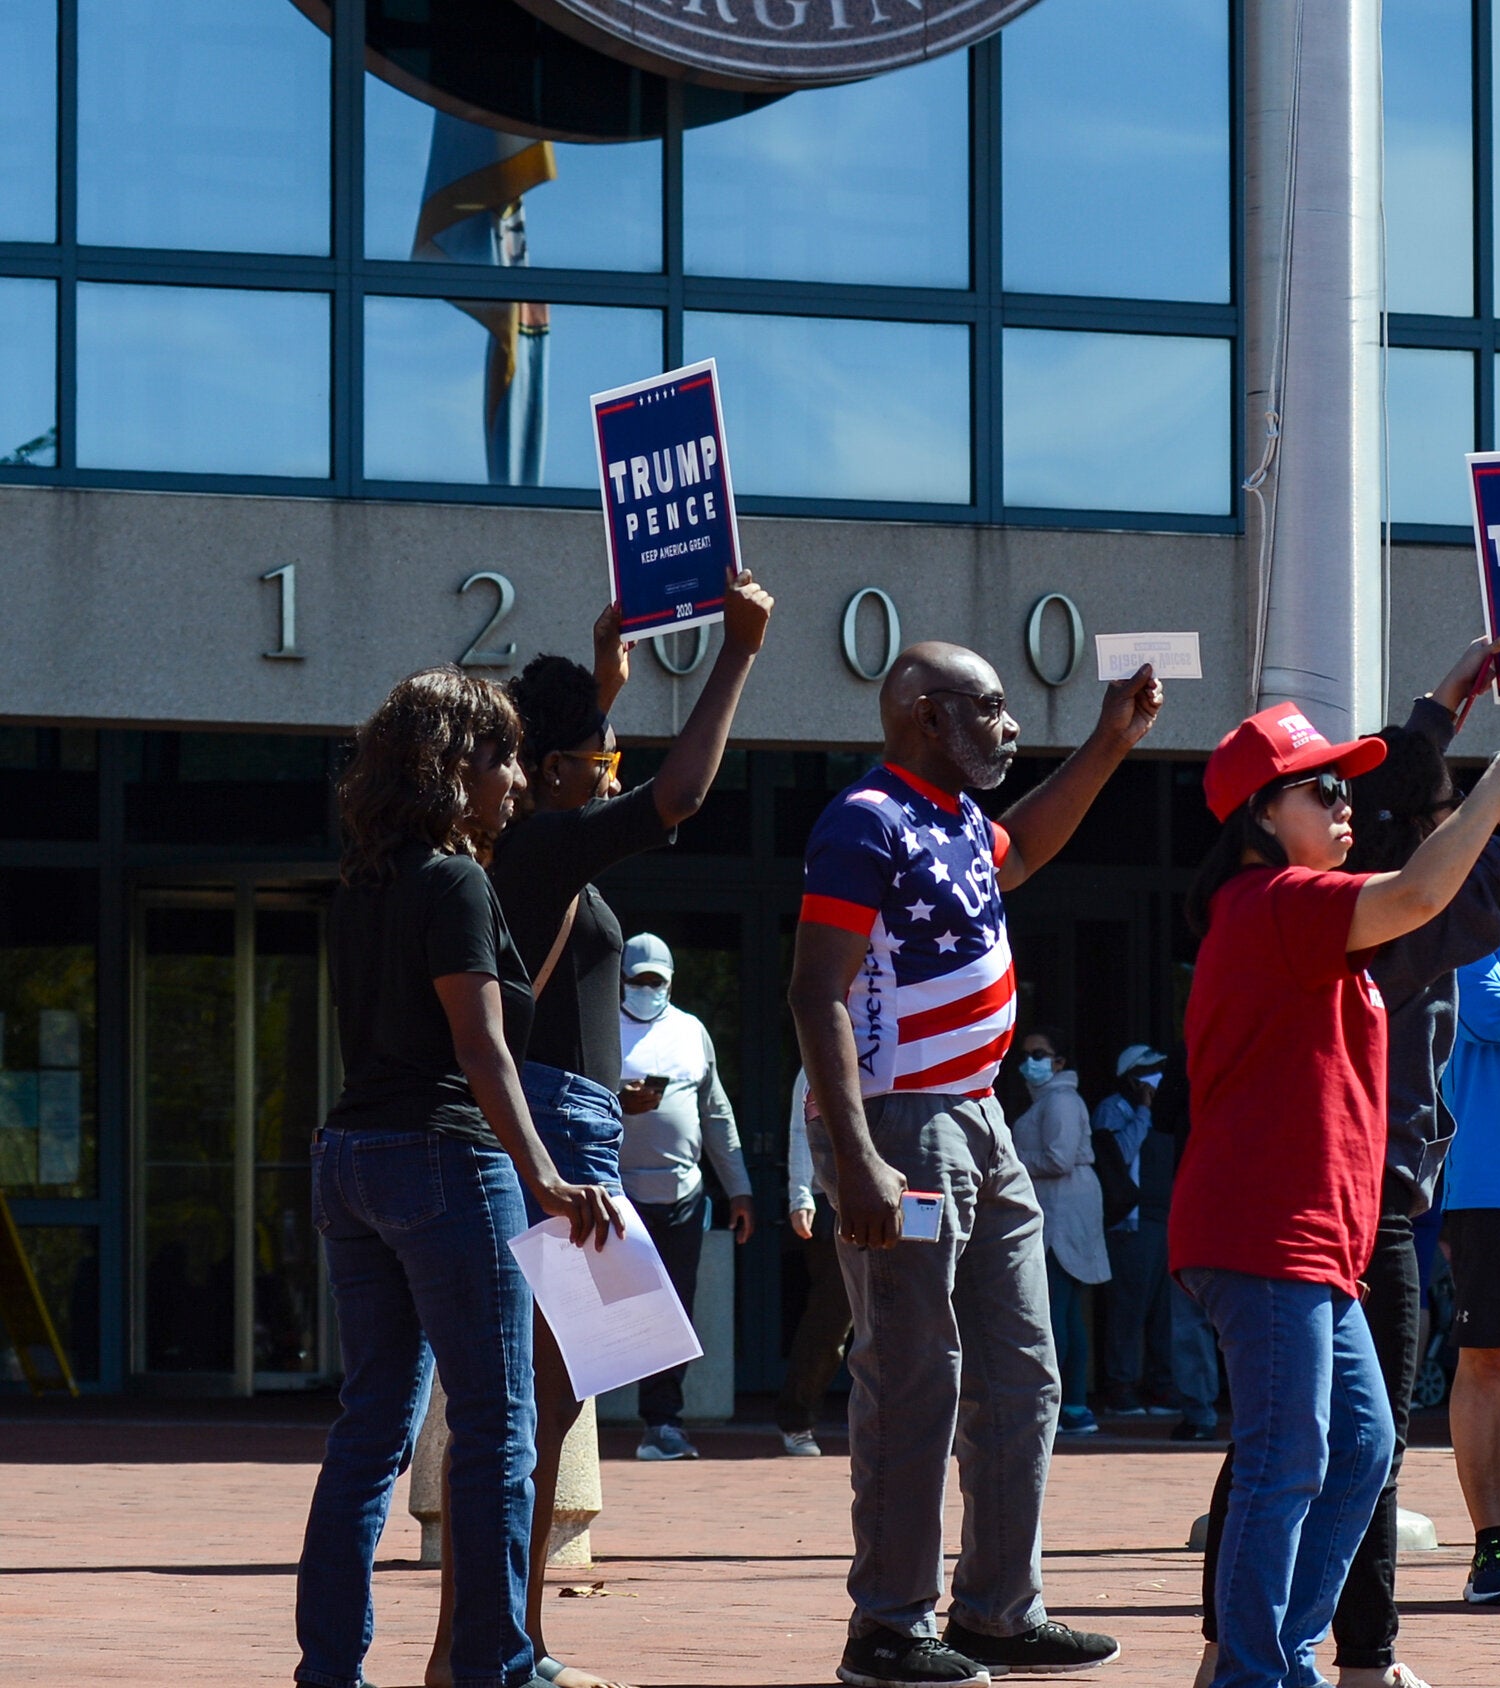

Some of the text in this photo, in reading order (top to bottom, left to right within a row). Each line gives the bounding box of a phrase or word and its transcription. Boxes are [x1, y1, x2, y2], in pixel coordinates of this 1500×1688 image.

[608, 435, 717, 504] TRUMP
[626, 491, 717, 541] PENCE
[640, 535, 712, 564] KEEP AMERICA GREAT!
[676, 602, 694, 619] 2020
[952, 855, 994, 918] US
